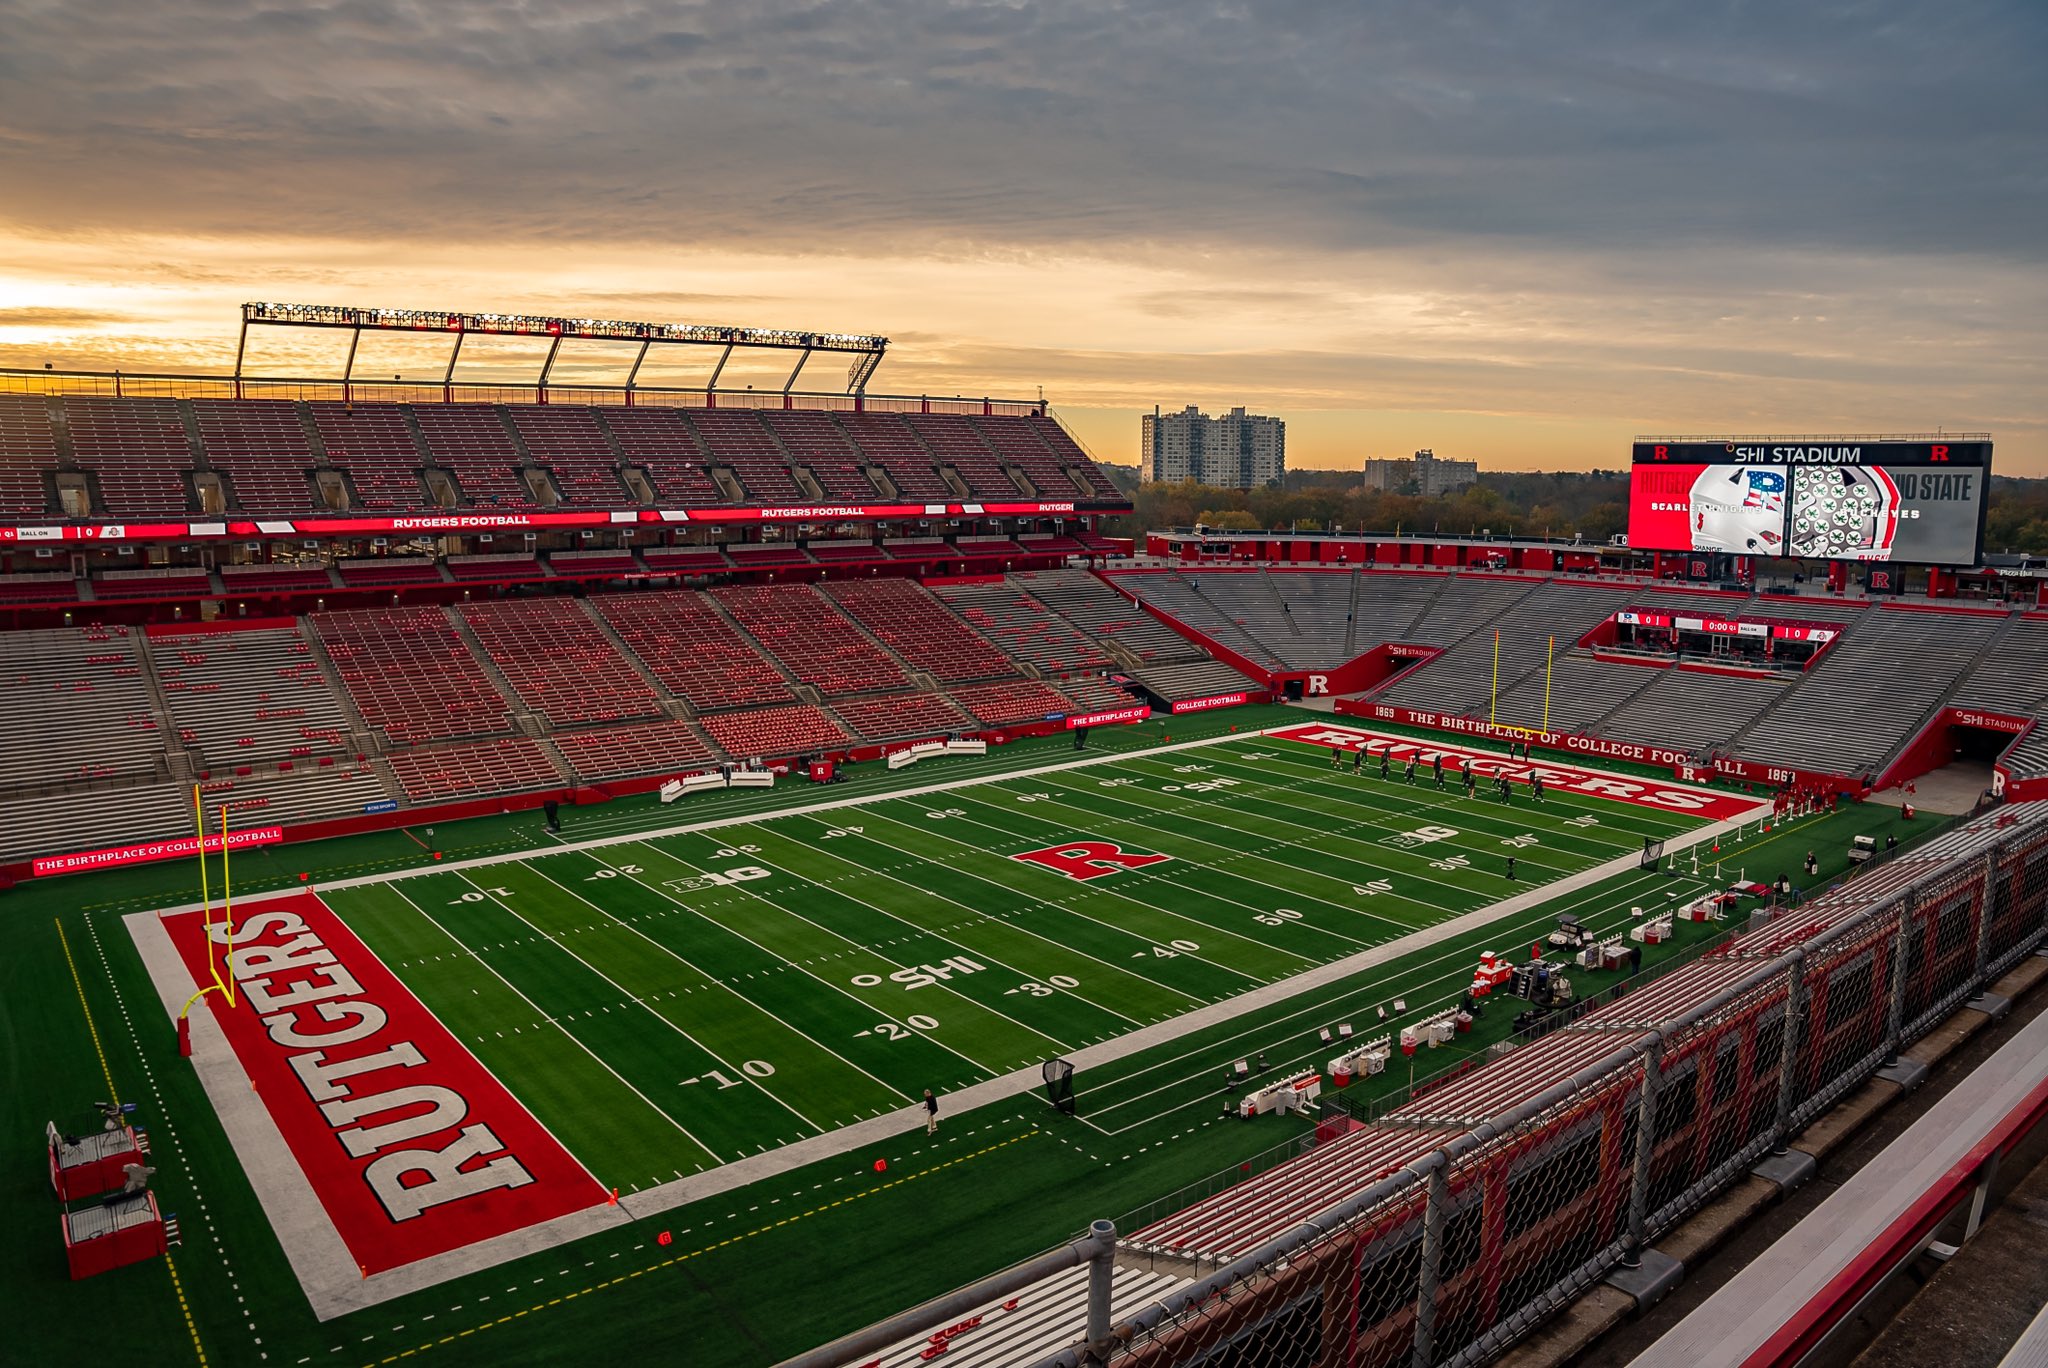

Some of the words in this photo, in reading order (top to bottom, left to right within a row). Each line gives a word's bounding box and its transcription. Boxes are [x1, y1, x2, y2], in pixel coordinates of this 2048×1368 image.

[1654, 446, 1668, 460] R
[1735, 447, 1764, 462] SHI
[1772, 447, 1861, 463] STADIUM
[1930, 445, 1949, 461] R
[1921, 474, 1973, 501] STATE
[761, 508, 811, 517] RUTGERS
[812, 507, 864, 516] FOOTBALL
[1651, 502, 1703, 512] SCARLET
[393, 518, 459, 528] RUTGERS
[461, 515, 530, 526] FOOTBALL
[85, 528, 93, 537] 0
[1691, 561, 1707, 577] R
[1870, 571, 1890, 589] R
[1645, 616, 1651, 624] 0
[1709, 621, 1728, 632] 0:00
[1794, 629, 1800, 638] 0
[1393, 647, 1407, 655] SHI
[1309, 675, 1329, 693] R
[1176, 700, 1207, 711] COLLEGE
[1208, 695, 1242, 706] FOOTBALL
[1072, 717, 1087, 726] THE
[1088, 711, 1132, 723] BIRTHPLACE
[1133, 709, 1143, 717] OF
[1961, 714, 1983, 725] SHI
[1984, 718, 2025, 731] STADIUM
[1375, 706, 1394, 718] 1869
[1408, 711, 1436, 726] THE
[1441, 717, 1534, 741] BIRTHPLACE
[1540, 732, 1561, 745] OF
[1567, 736, 1644, 759] COLLEGE
[1651, 749, 1748, 776] FOOALL
[817, 767, 825, 775] R
[1298, 730, 1717, 809] RUTGERS
[1682, 767, 1695, 781] R
[1992, 769, 2006, 796] R
[926, 808, 967, 820] 50
[1563, 815, 1600, 828] 10
[1501, 836, 1540, 849] 20
[37, 859, 64, 871] THE
[67, 849, 146, 866] BIRTHPLACE
[148, 844, 165, 855] OF
[166, 838, 219, 853] COLLEGE
[717, 844, 762, 858] 30
[1007, 840, 1176, 882] R
[1429, 858, 1471, 871] 30
[595, 864, 644, 879] 20
[461, 886, 515, 902] 10
[1352, 879, 1393, 897] 40
[1252, 908, 1303, 927] 50
[1152, 939, 1200, 959] 40
[889, 955, 988, 991] SHI
[1019, 975, 1080, 997] 30
[874, 1014, 940, 1041] 20
[203, 911, 537, 1225] RUTGERS
[701, 1060, 776, 1090] 10
